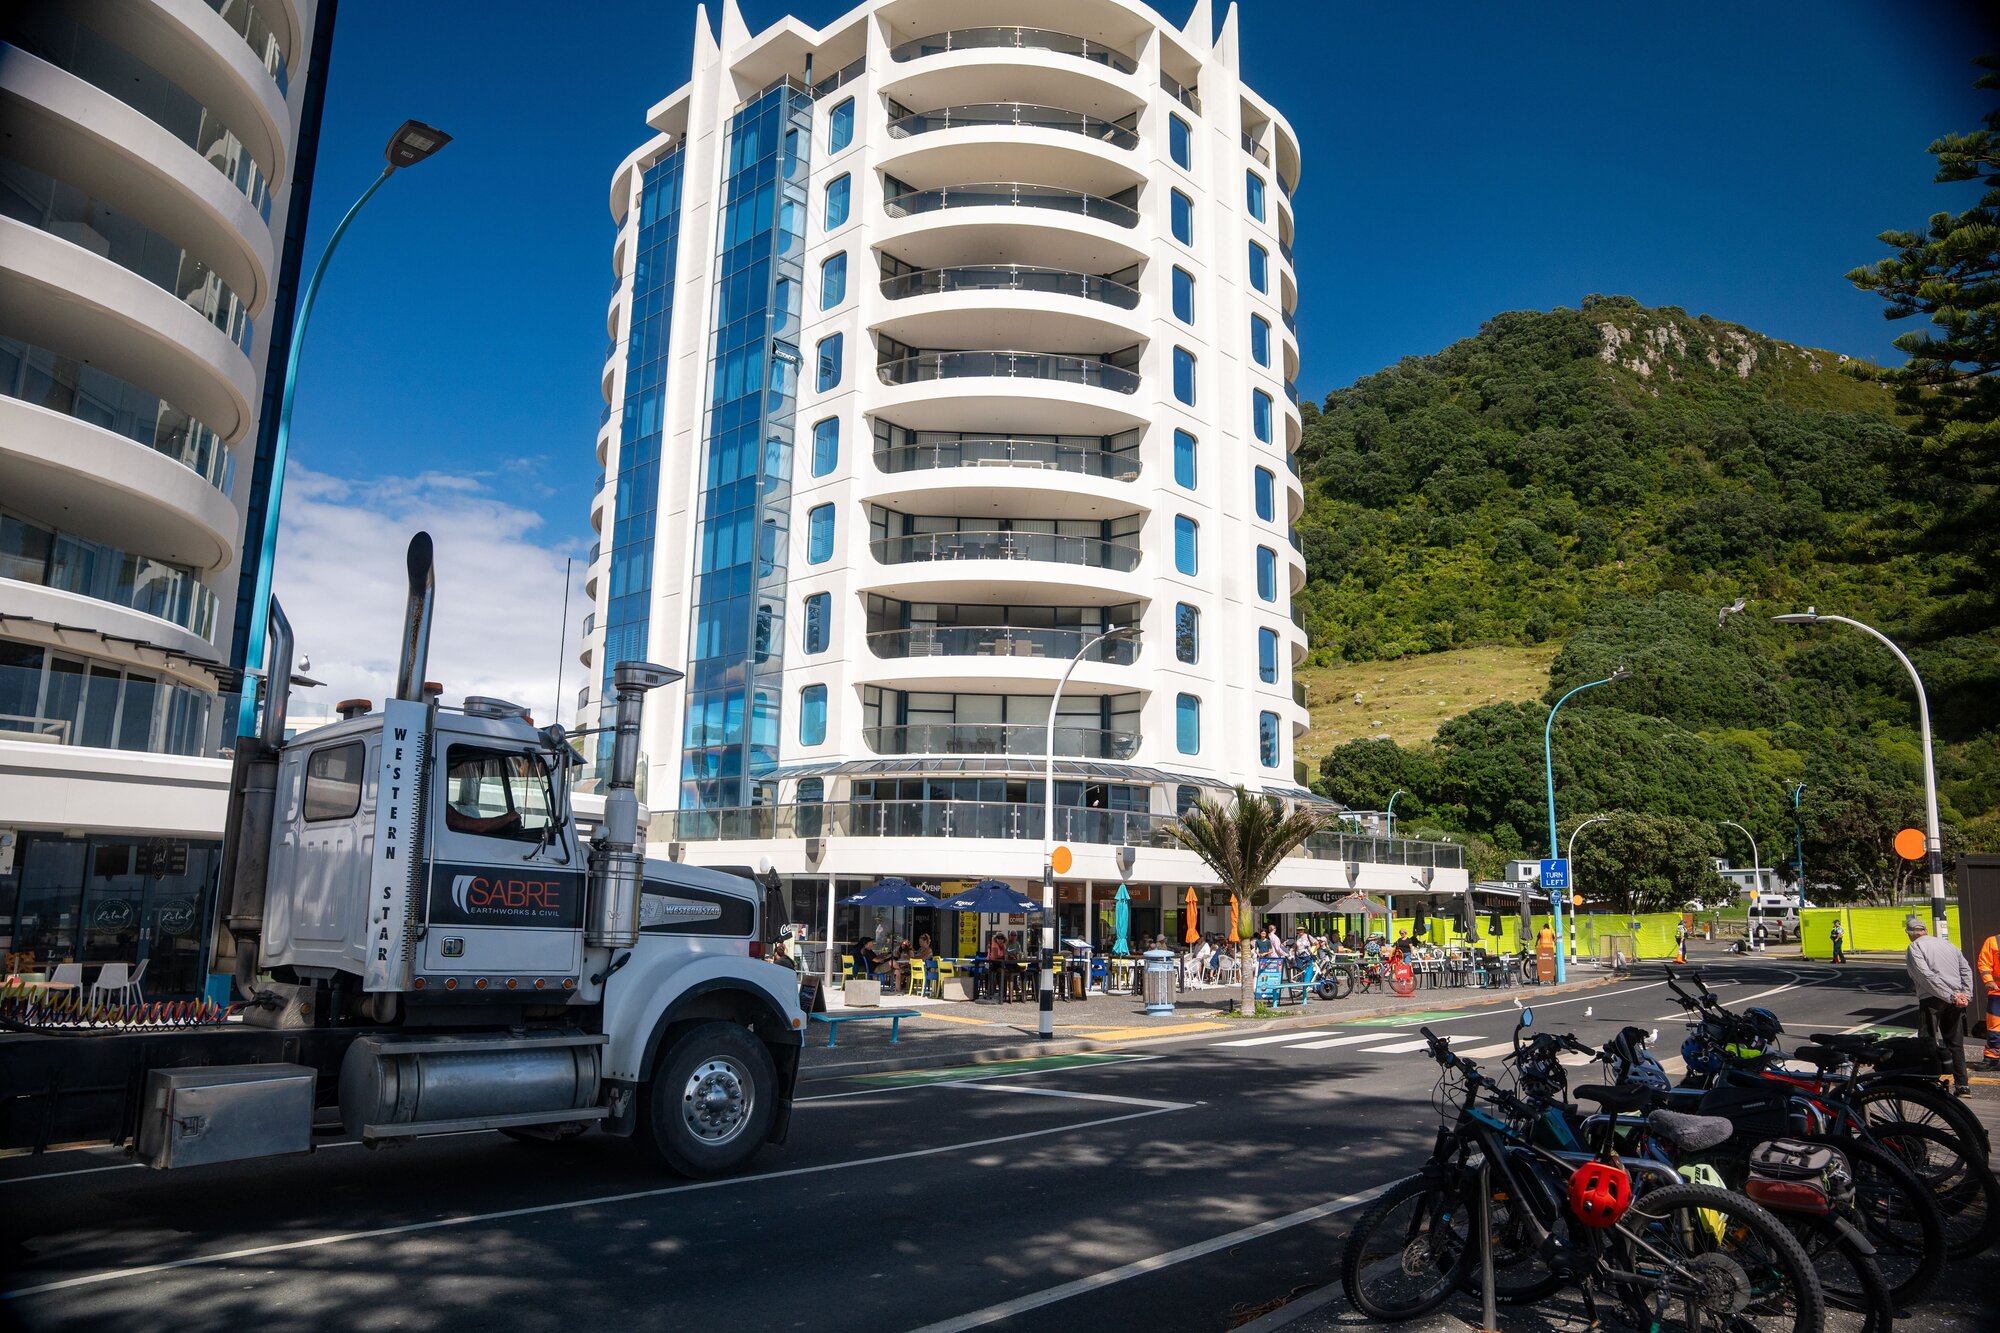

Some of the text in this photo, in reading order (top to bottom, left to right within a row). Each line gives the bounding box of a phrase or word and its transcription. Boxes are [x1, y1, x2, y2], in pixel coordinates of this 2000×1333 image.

[377, 727, 408, 961] WESTERN STAR
[470, 877, 561, 908] SABRE
[470, 906, 530, 916] EARTHWORKS
